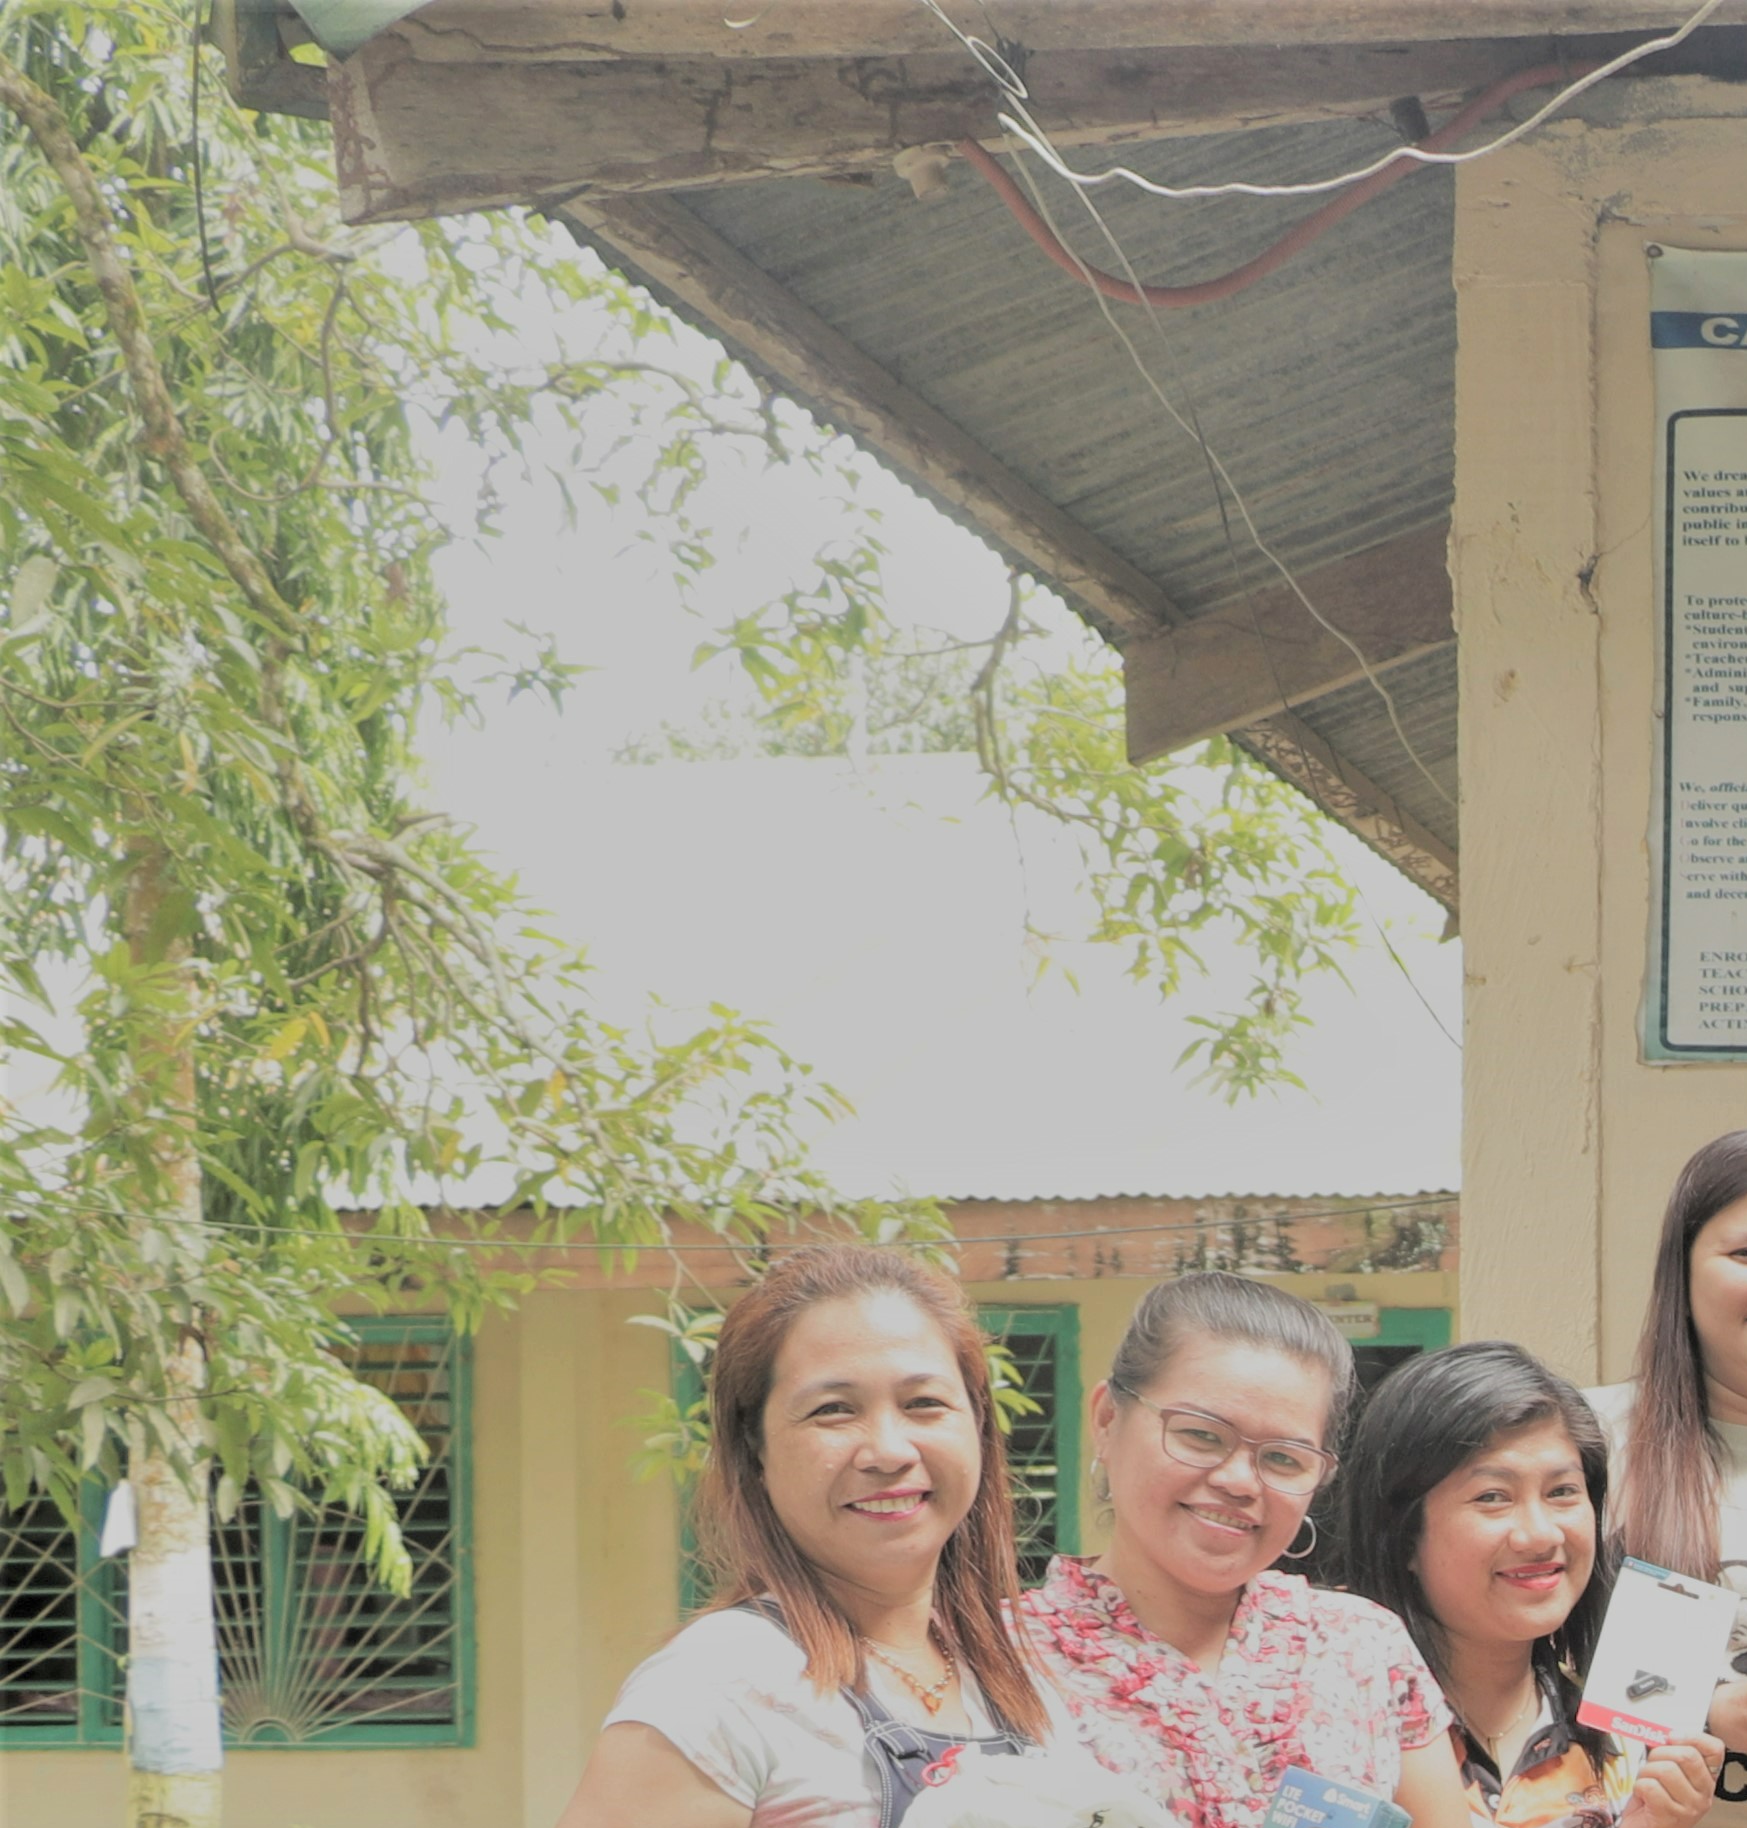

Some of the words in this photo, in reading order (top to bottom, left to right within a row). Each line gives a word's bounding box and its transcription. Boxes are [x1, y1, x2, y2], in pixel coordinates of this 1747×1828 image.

[1683, 470, 1708, 481] We
[1683, 487, 1731, 498] values
[1682, 519, 1731, 532] public
[1682, 535, 1721, 546] itself
[1724, 536, 1740, 546] to
[1281, 1785, 1304, 1801] LTE
[1336, 1792, 1372, 1815] Smart
[1275, 1798, 1326, 1825] POCKET
